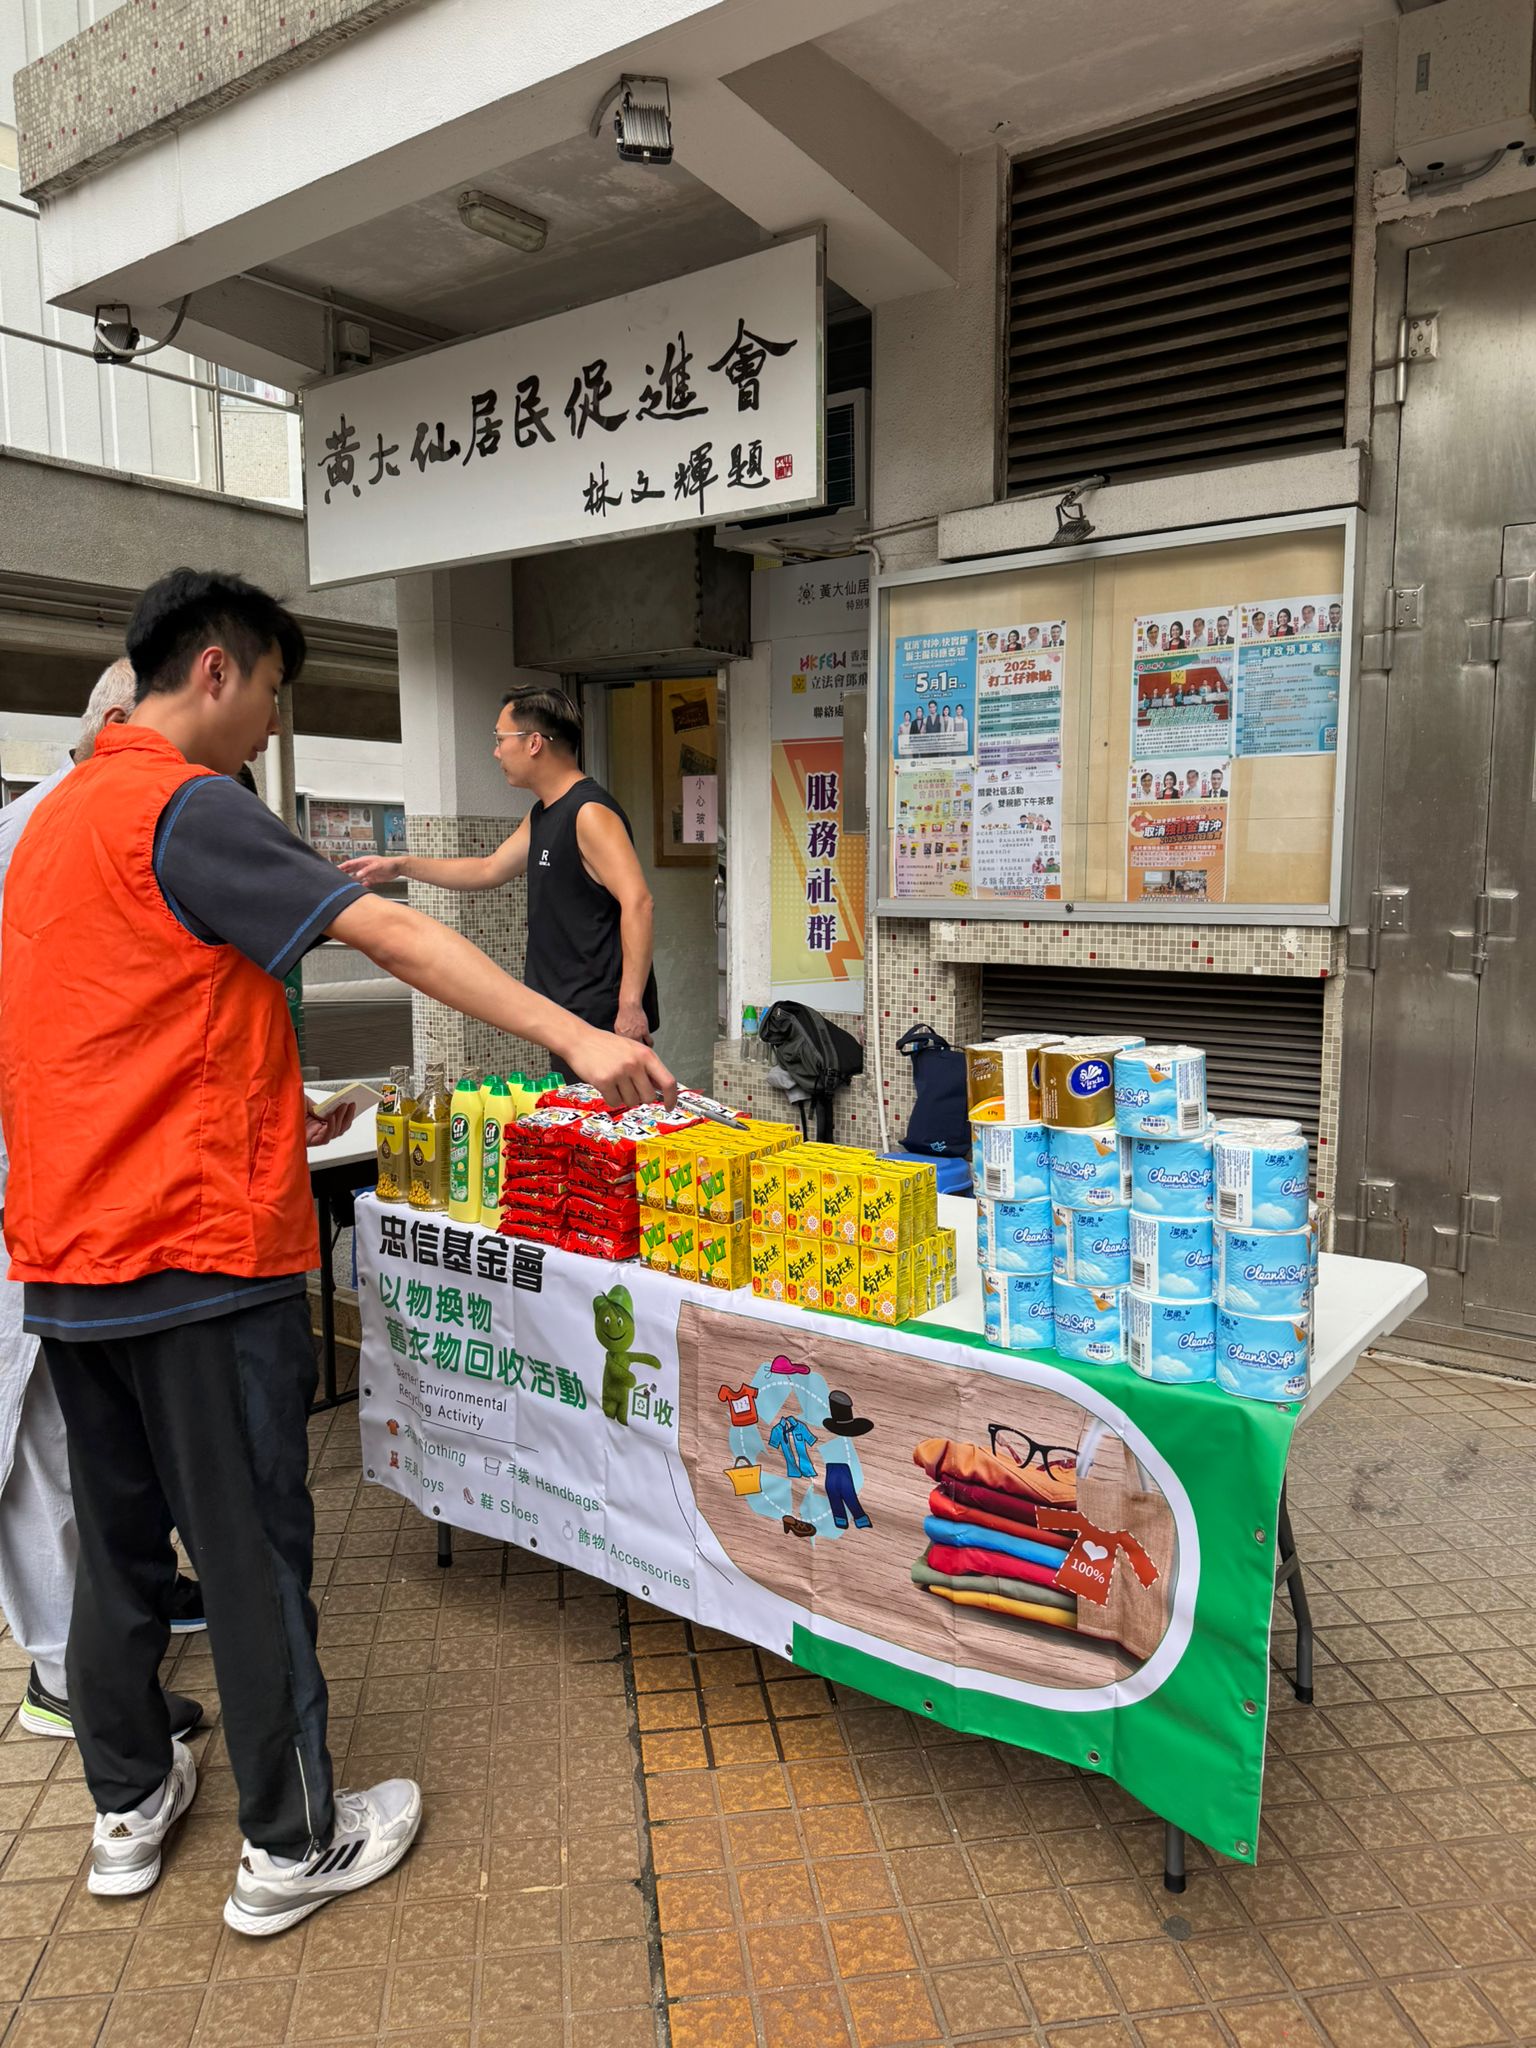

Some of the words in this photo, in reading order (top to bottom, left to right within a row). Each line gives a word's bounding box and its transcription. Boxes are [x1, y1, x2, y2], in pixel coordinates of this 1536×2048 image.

[317, 317, 798, 504] 黃大仙居民促進會
[799, 651, 846, 672] HKFEW
[1004, 659, 1036, 672] 2025
[988, 670, 1052, 688] 打工仔津貼
[806, 772, 838, 951] 服務社群
[453, 1119, 465, 1133] Cif
[485, 1124, 496, 1138] Cif
[753, 1175, 781, 1207] 菊花茶
[788, 1180, 818, 1212] 菊花茶
[823, 1185, 855, 1217] 菊花茶
[863, 1191, 897, 1223] 菊花茶
[378, 1214, 547, 1294] 忠信基金會
[753, 1243, 781, 1276] 菊花茶
[788, 1251, 818, 1282] 菊花茶
[824, 1256, 856, 1289] 菊花茶
[862, 1263, 895, 1296] 菊花茶
[378, 1271, 493, 1334] 以物換物
[385, 1314, 588, 1411] 舊衣物回收活動
[419, 1380, 507, 1413] Environmental
[437, 1405, 484, 1431] Activity
[506, 1462, 531, 1486] 手袋
[535, 1475, 600, 1512] Handbags
[479, 1492, 494, 1510] 鞋
[500, 1498, 540, 1525] Shoes
[578, 1526, 606, 1551] 飾物
[610, 1543, 691, 1590] Accessories
[1071, 1558, 1105, 1584] 100%
